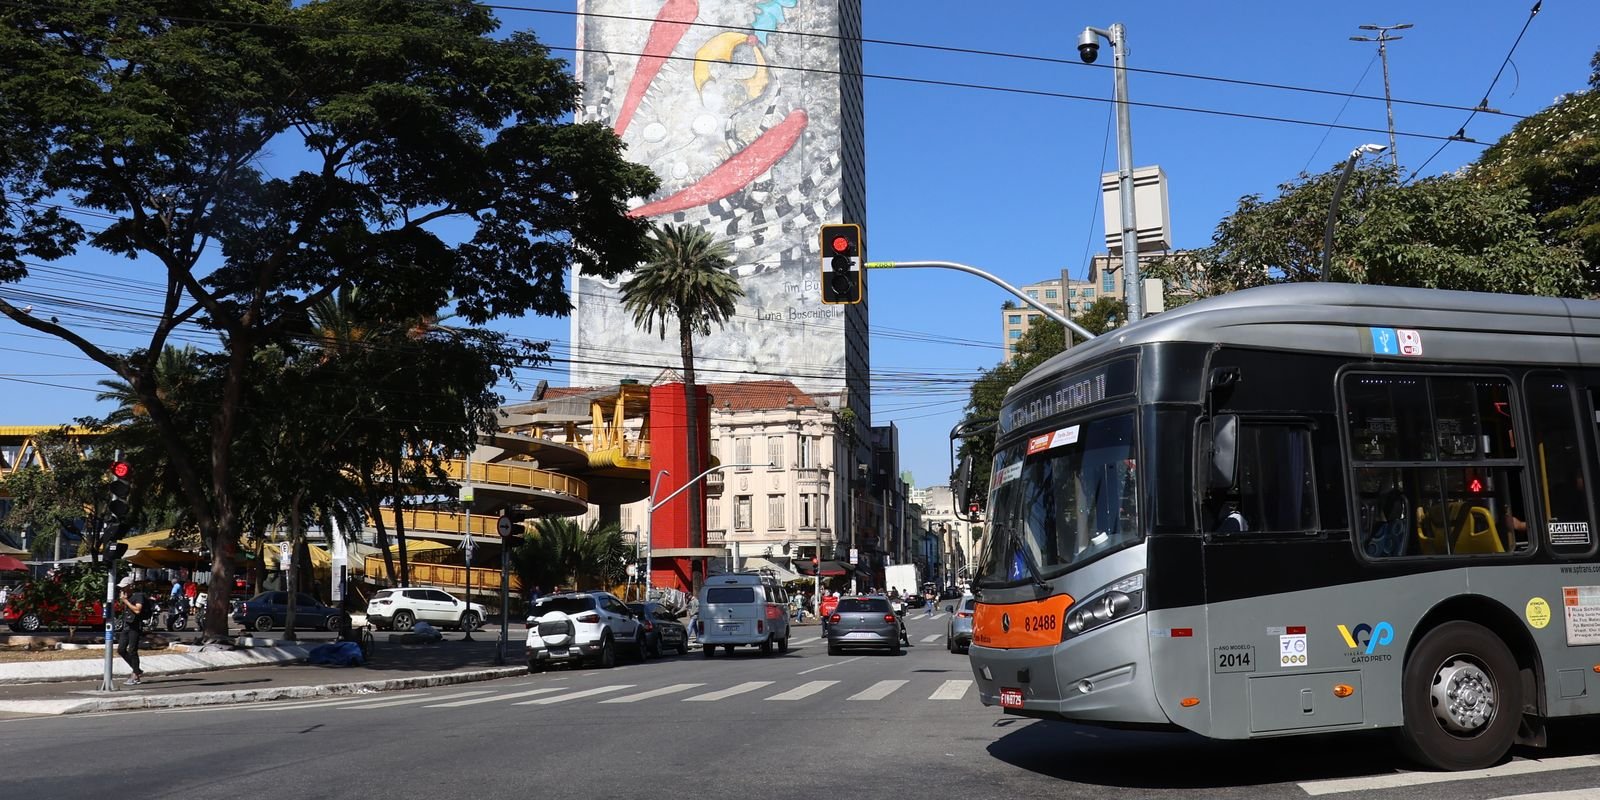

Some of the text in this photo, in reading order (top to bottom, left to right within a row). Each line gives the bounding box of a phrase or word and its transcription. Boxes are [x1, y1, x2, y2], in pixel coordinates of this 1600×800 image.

[783, 282, 800, 293] Tim
[1025, 614, 1056, 631] 8 2488
[1219, 652, 1250, 667] 2014
[1351, 654, 1392, 664] GATO PRETO
